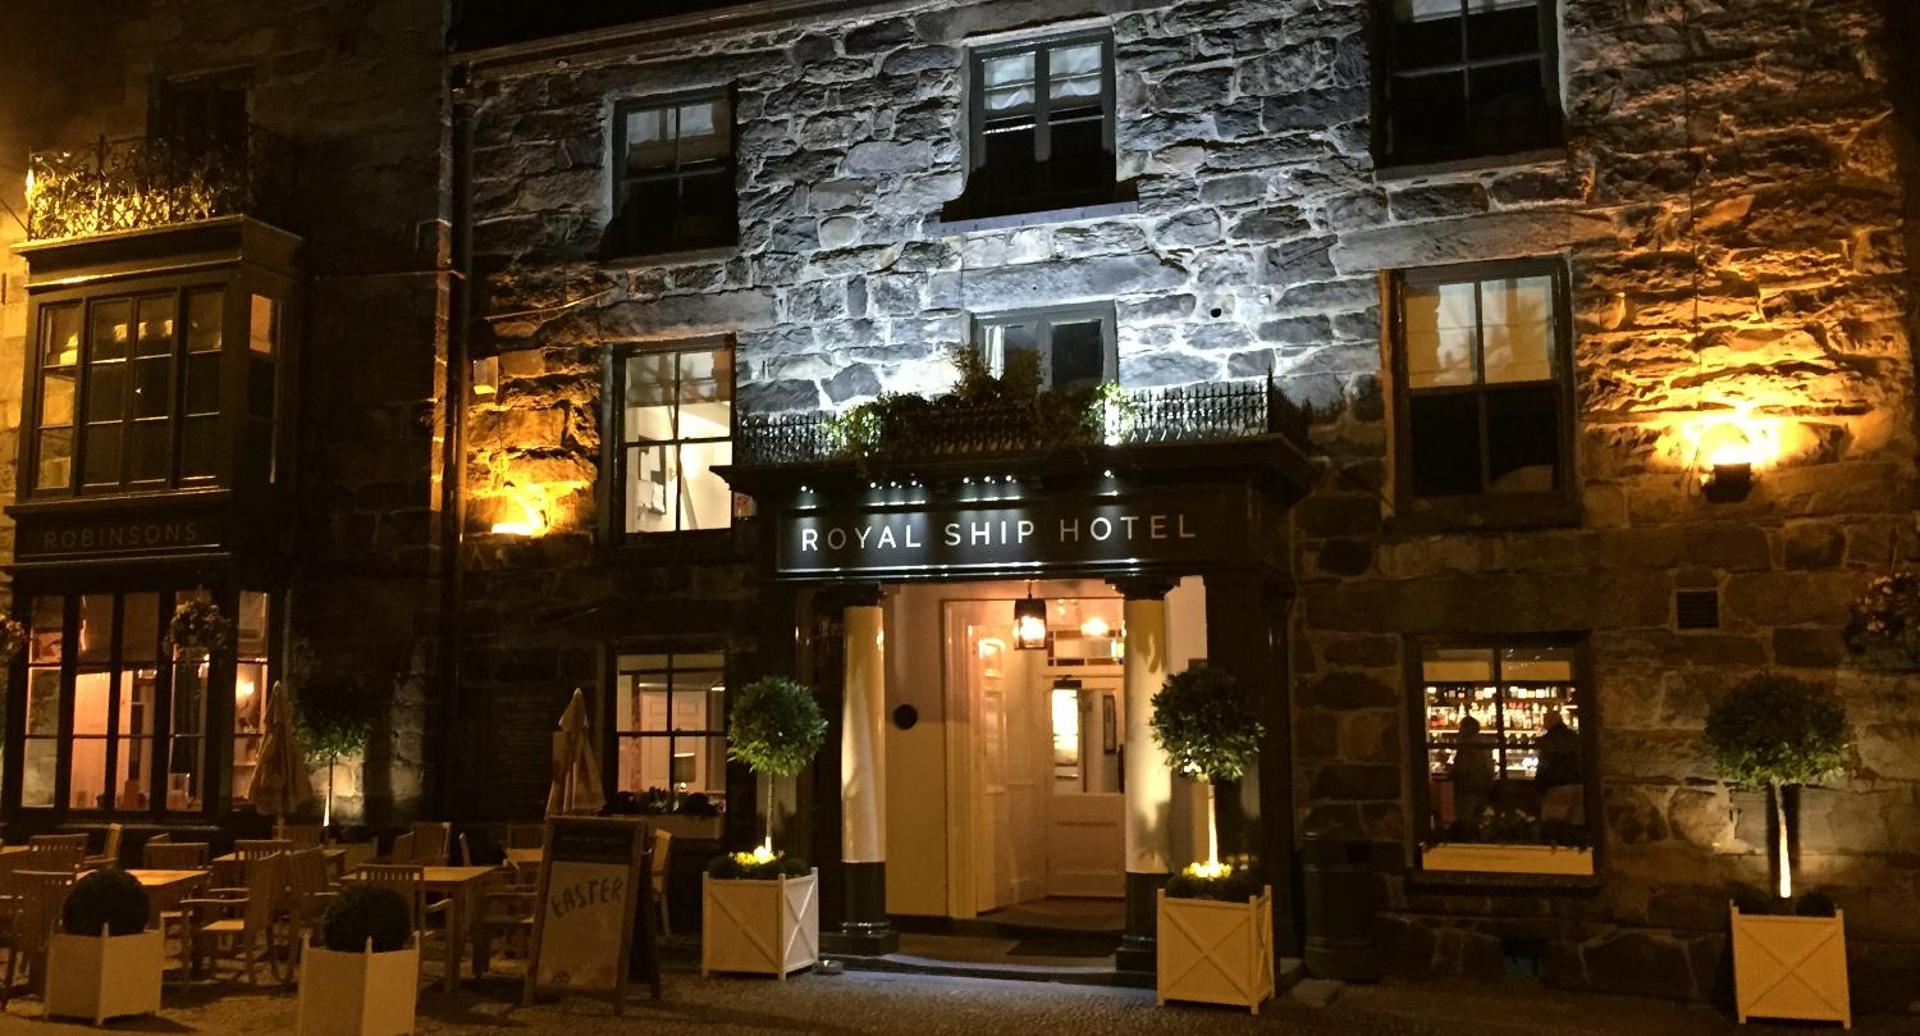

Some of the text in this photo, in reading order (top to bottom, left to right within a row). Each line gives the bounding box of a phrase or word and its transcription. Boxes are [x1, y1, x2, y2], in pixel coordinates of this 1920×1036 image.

[43, 523, 199, 549] ROBINSONS
[801, 513, 1198, 552] ROYAL SHIP HOTEL
[552, 878, 623, 918] EASTER
